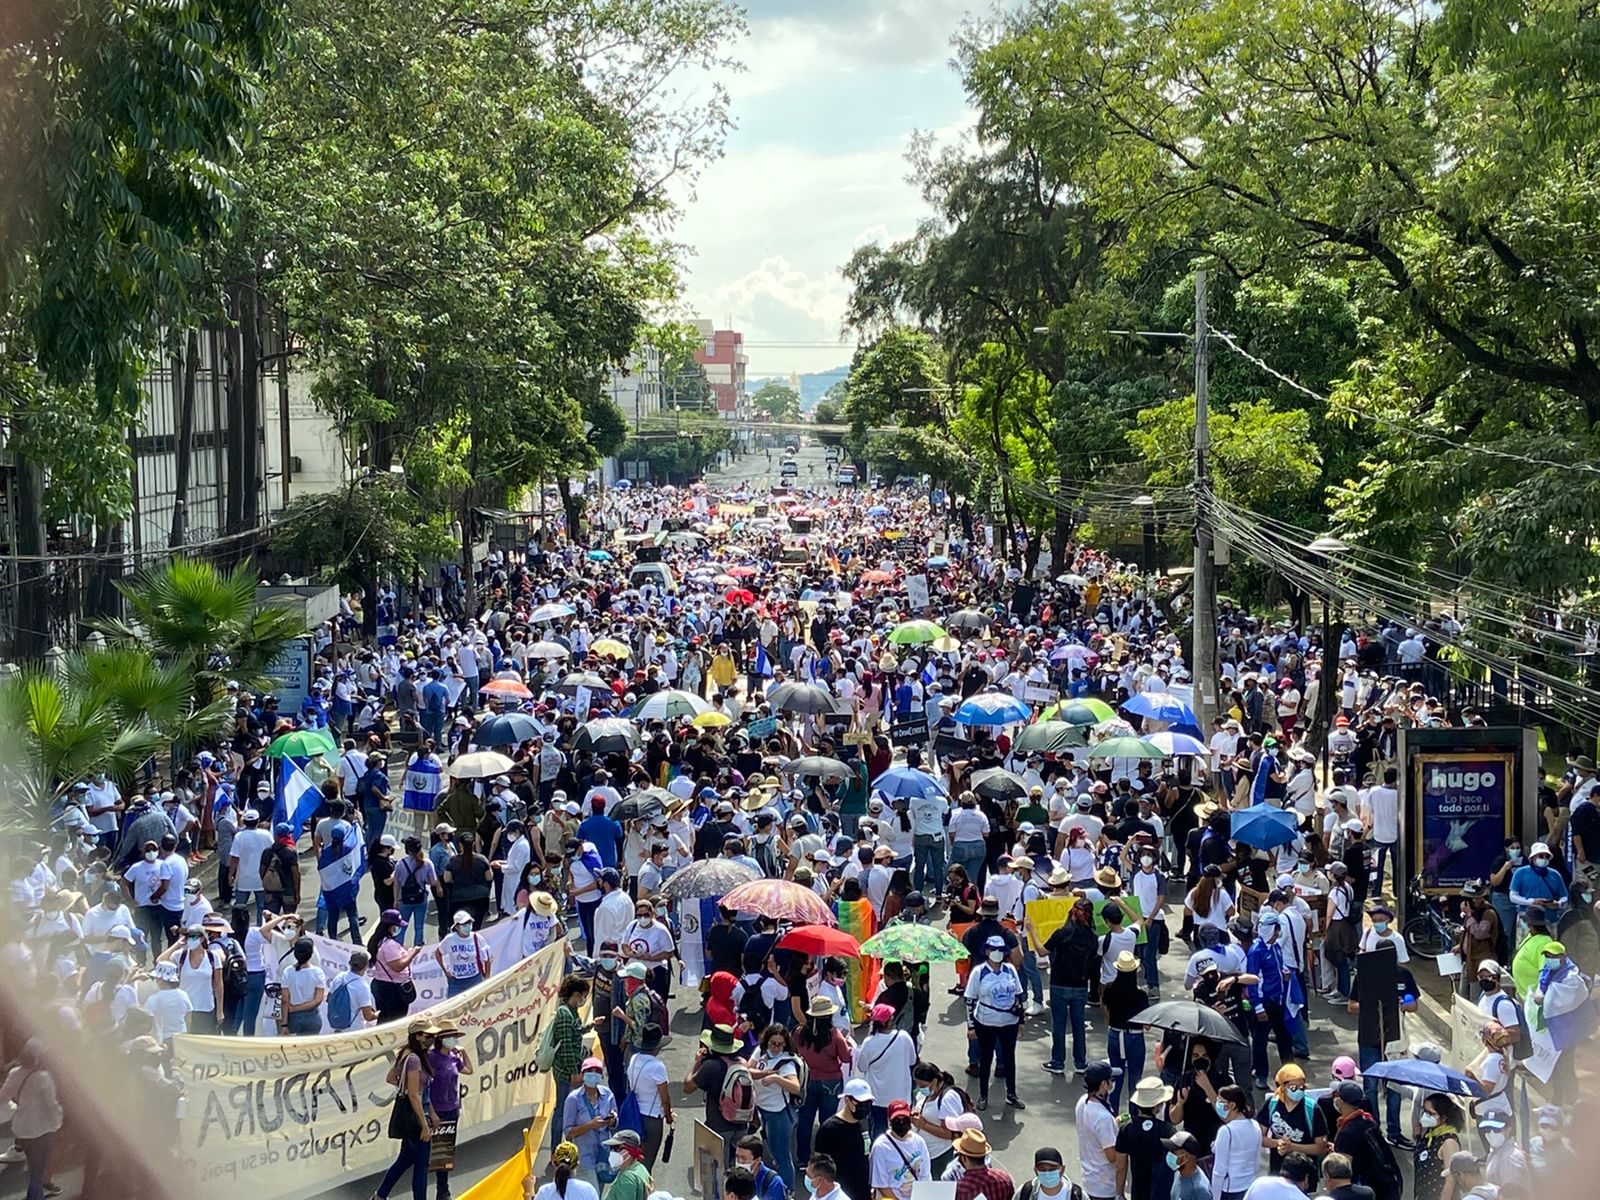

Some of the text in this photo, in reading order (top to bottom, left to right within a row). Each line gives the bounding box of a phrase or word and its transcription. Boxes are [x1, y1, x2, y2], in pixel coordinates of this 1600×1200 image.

[1431, 768, 1496, 791] hugo
[1444, 795, 1482, 803] Lo hace
[1439, 804, 1490, 814] todo por ti
